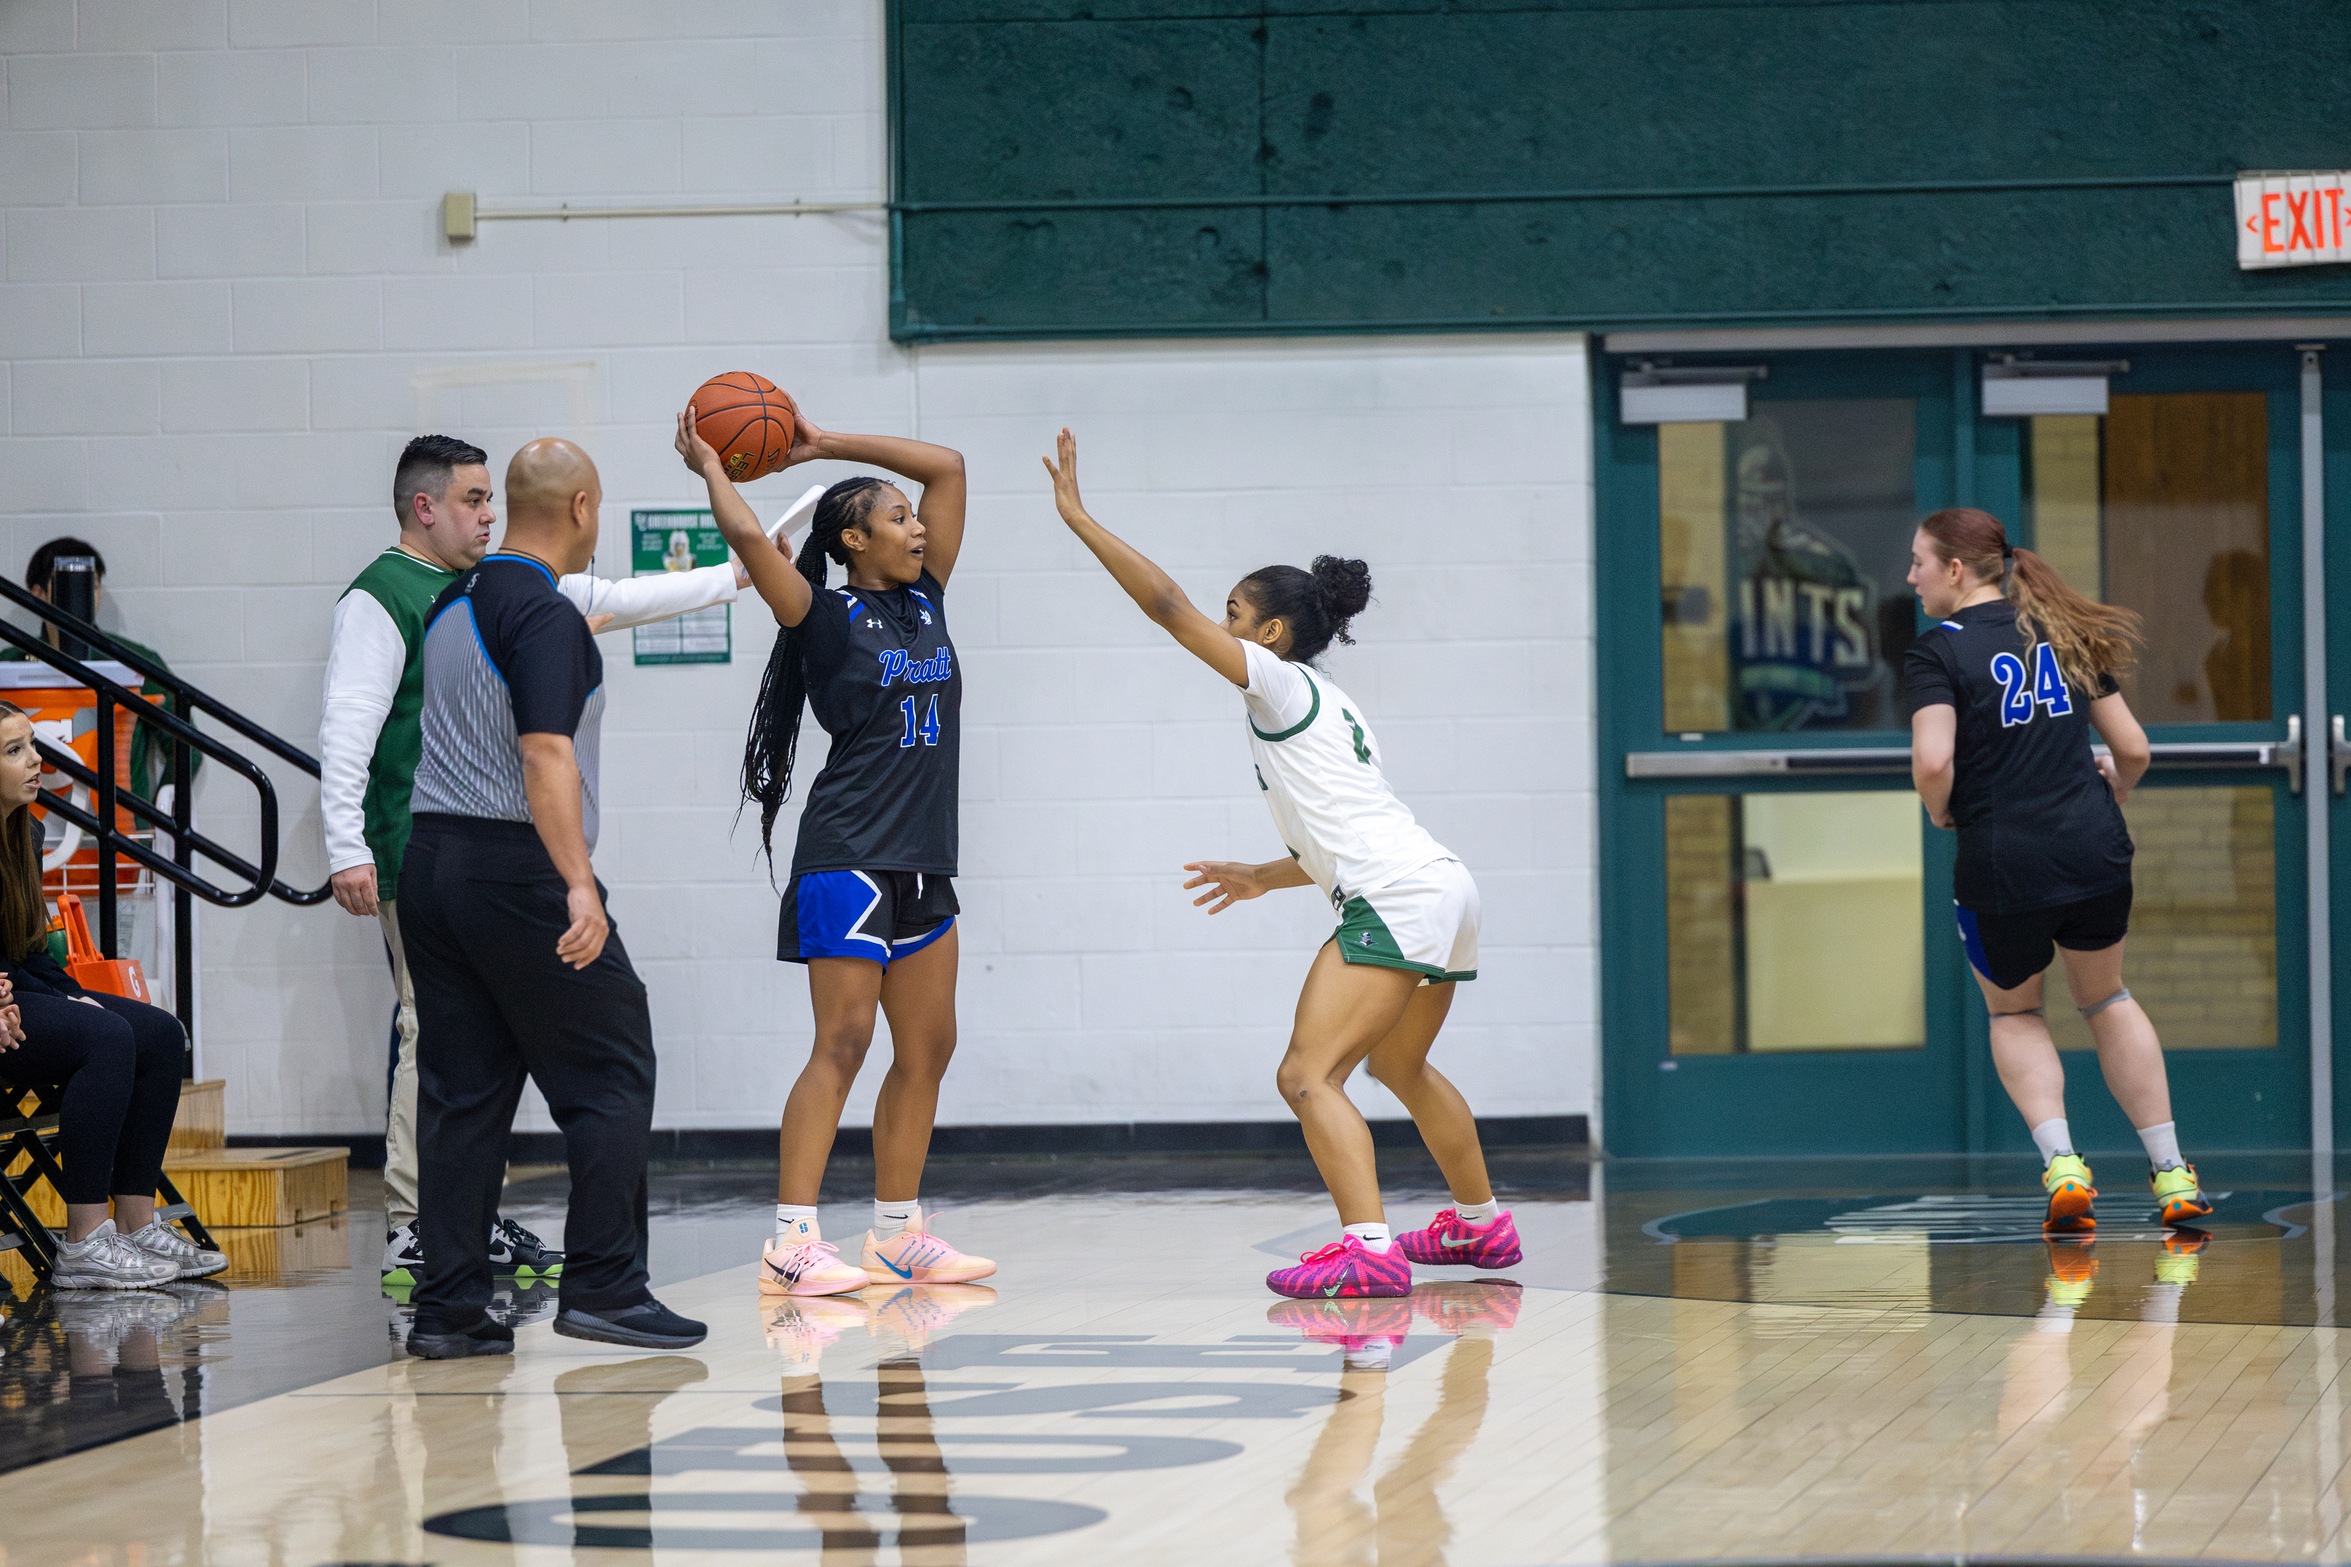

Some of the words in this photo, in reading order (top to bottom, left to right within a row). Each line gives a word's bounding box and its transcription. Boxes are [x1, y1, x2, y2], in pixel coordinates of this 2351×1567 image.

[2261, 188, 2345, 254] EXIT
[1739, 577, 1869, 667] INTS
[878, 646, 951, 687] Pratt
[1990, 642, 2073, 728] 24
[900, 694, 941, 749] 14
[422, 1334, 1458, 1550] OUSE
